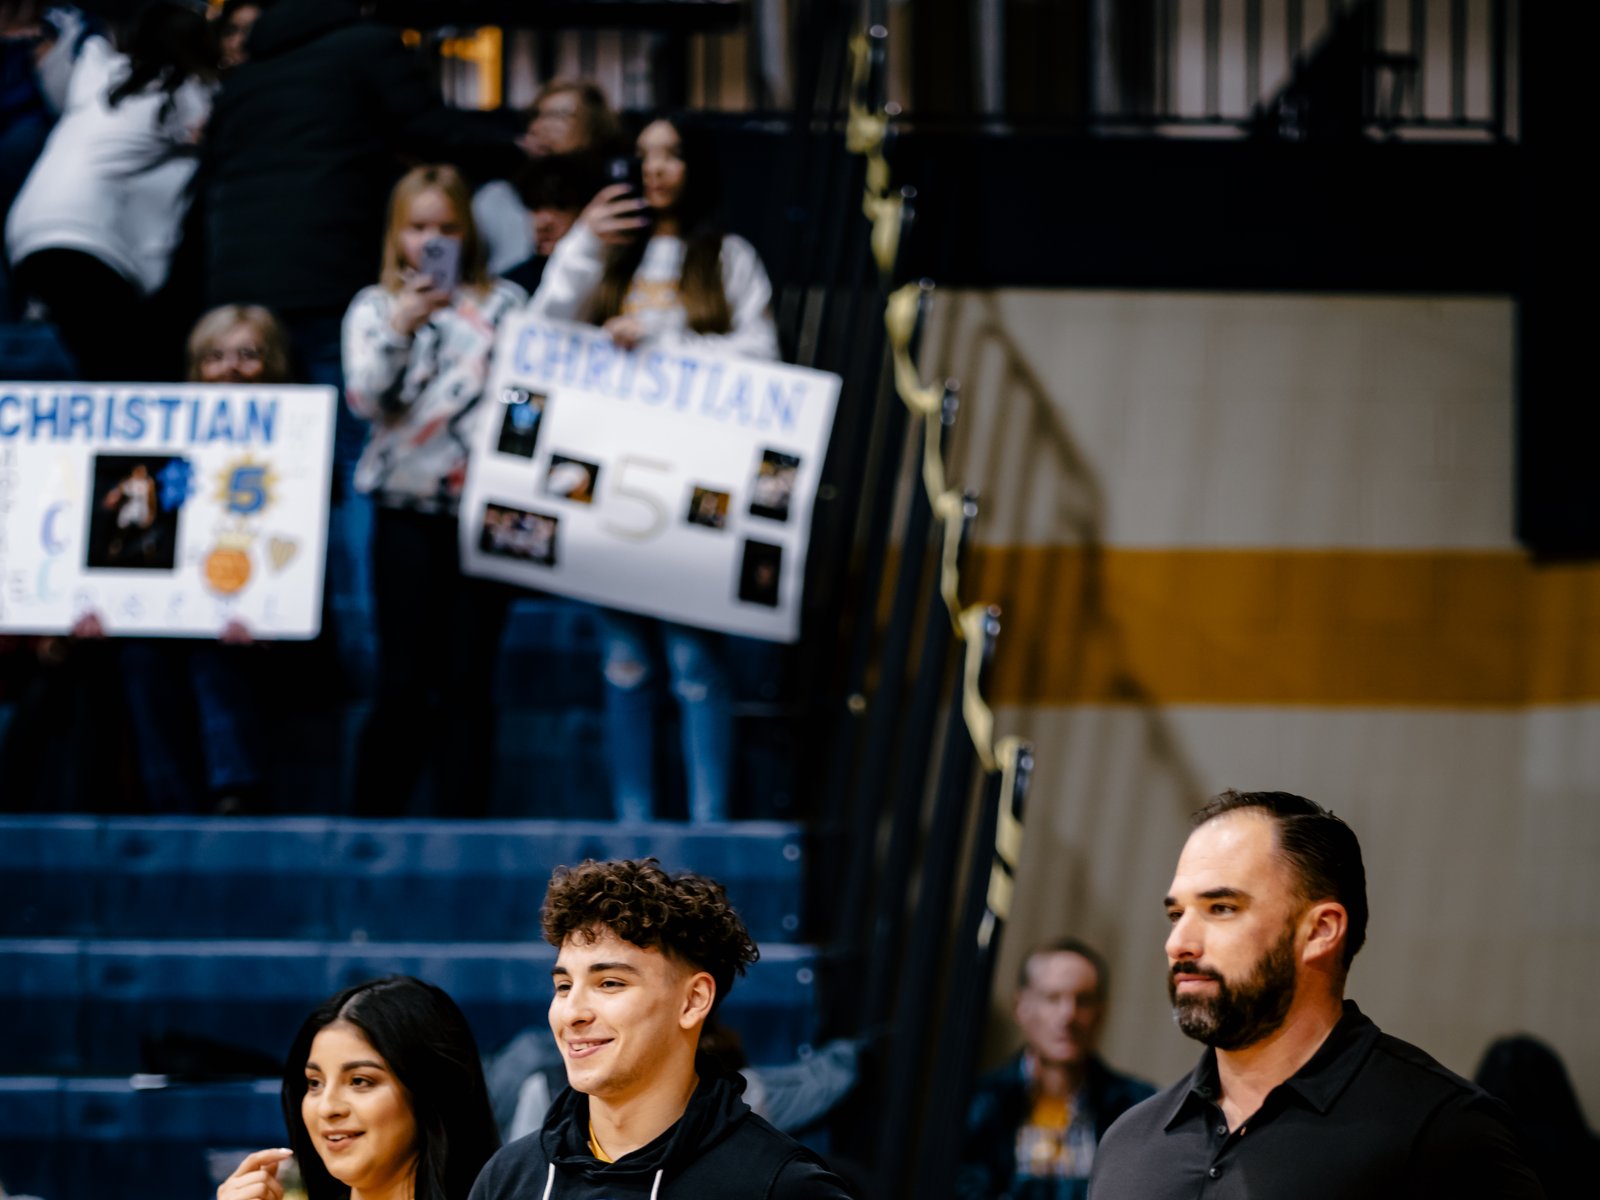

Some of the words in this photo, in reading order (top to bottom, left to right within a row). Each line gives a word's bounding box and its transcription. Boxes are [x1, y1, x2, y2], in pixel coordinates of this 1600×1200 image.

[513, 322, 808, 432] CHRISTIAN
[0, 395, 279, 442] CHRISTIAN
[226, 465, 266, 513] 5
[602, 453, 675, 543] 5
